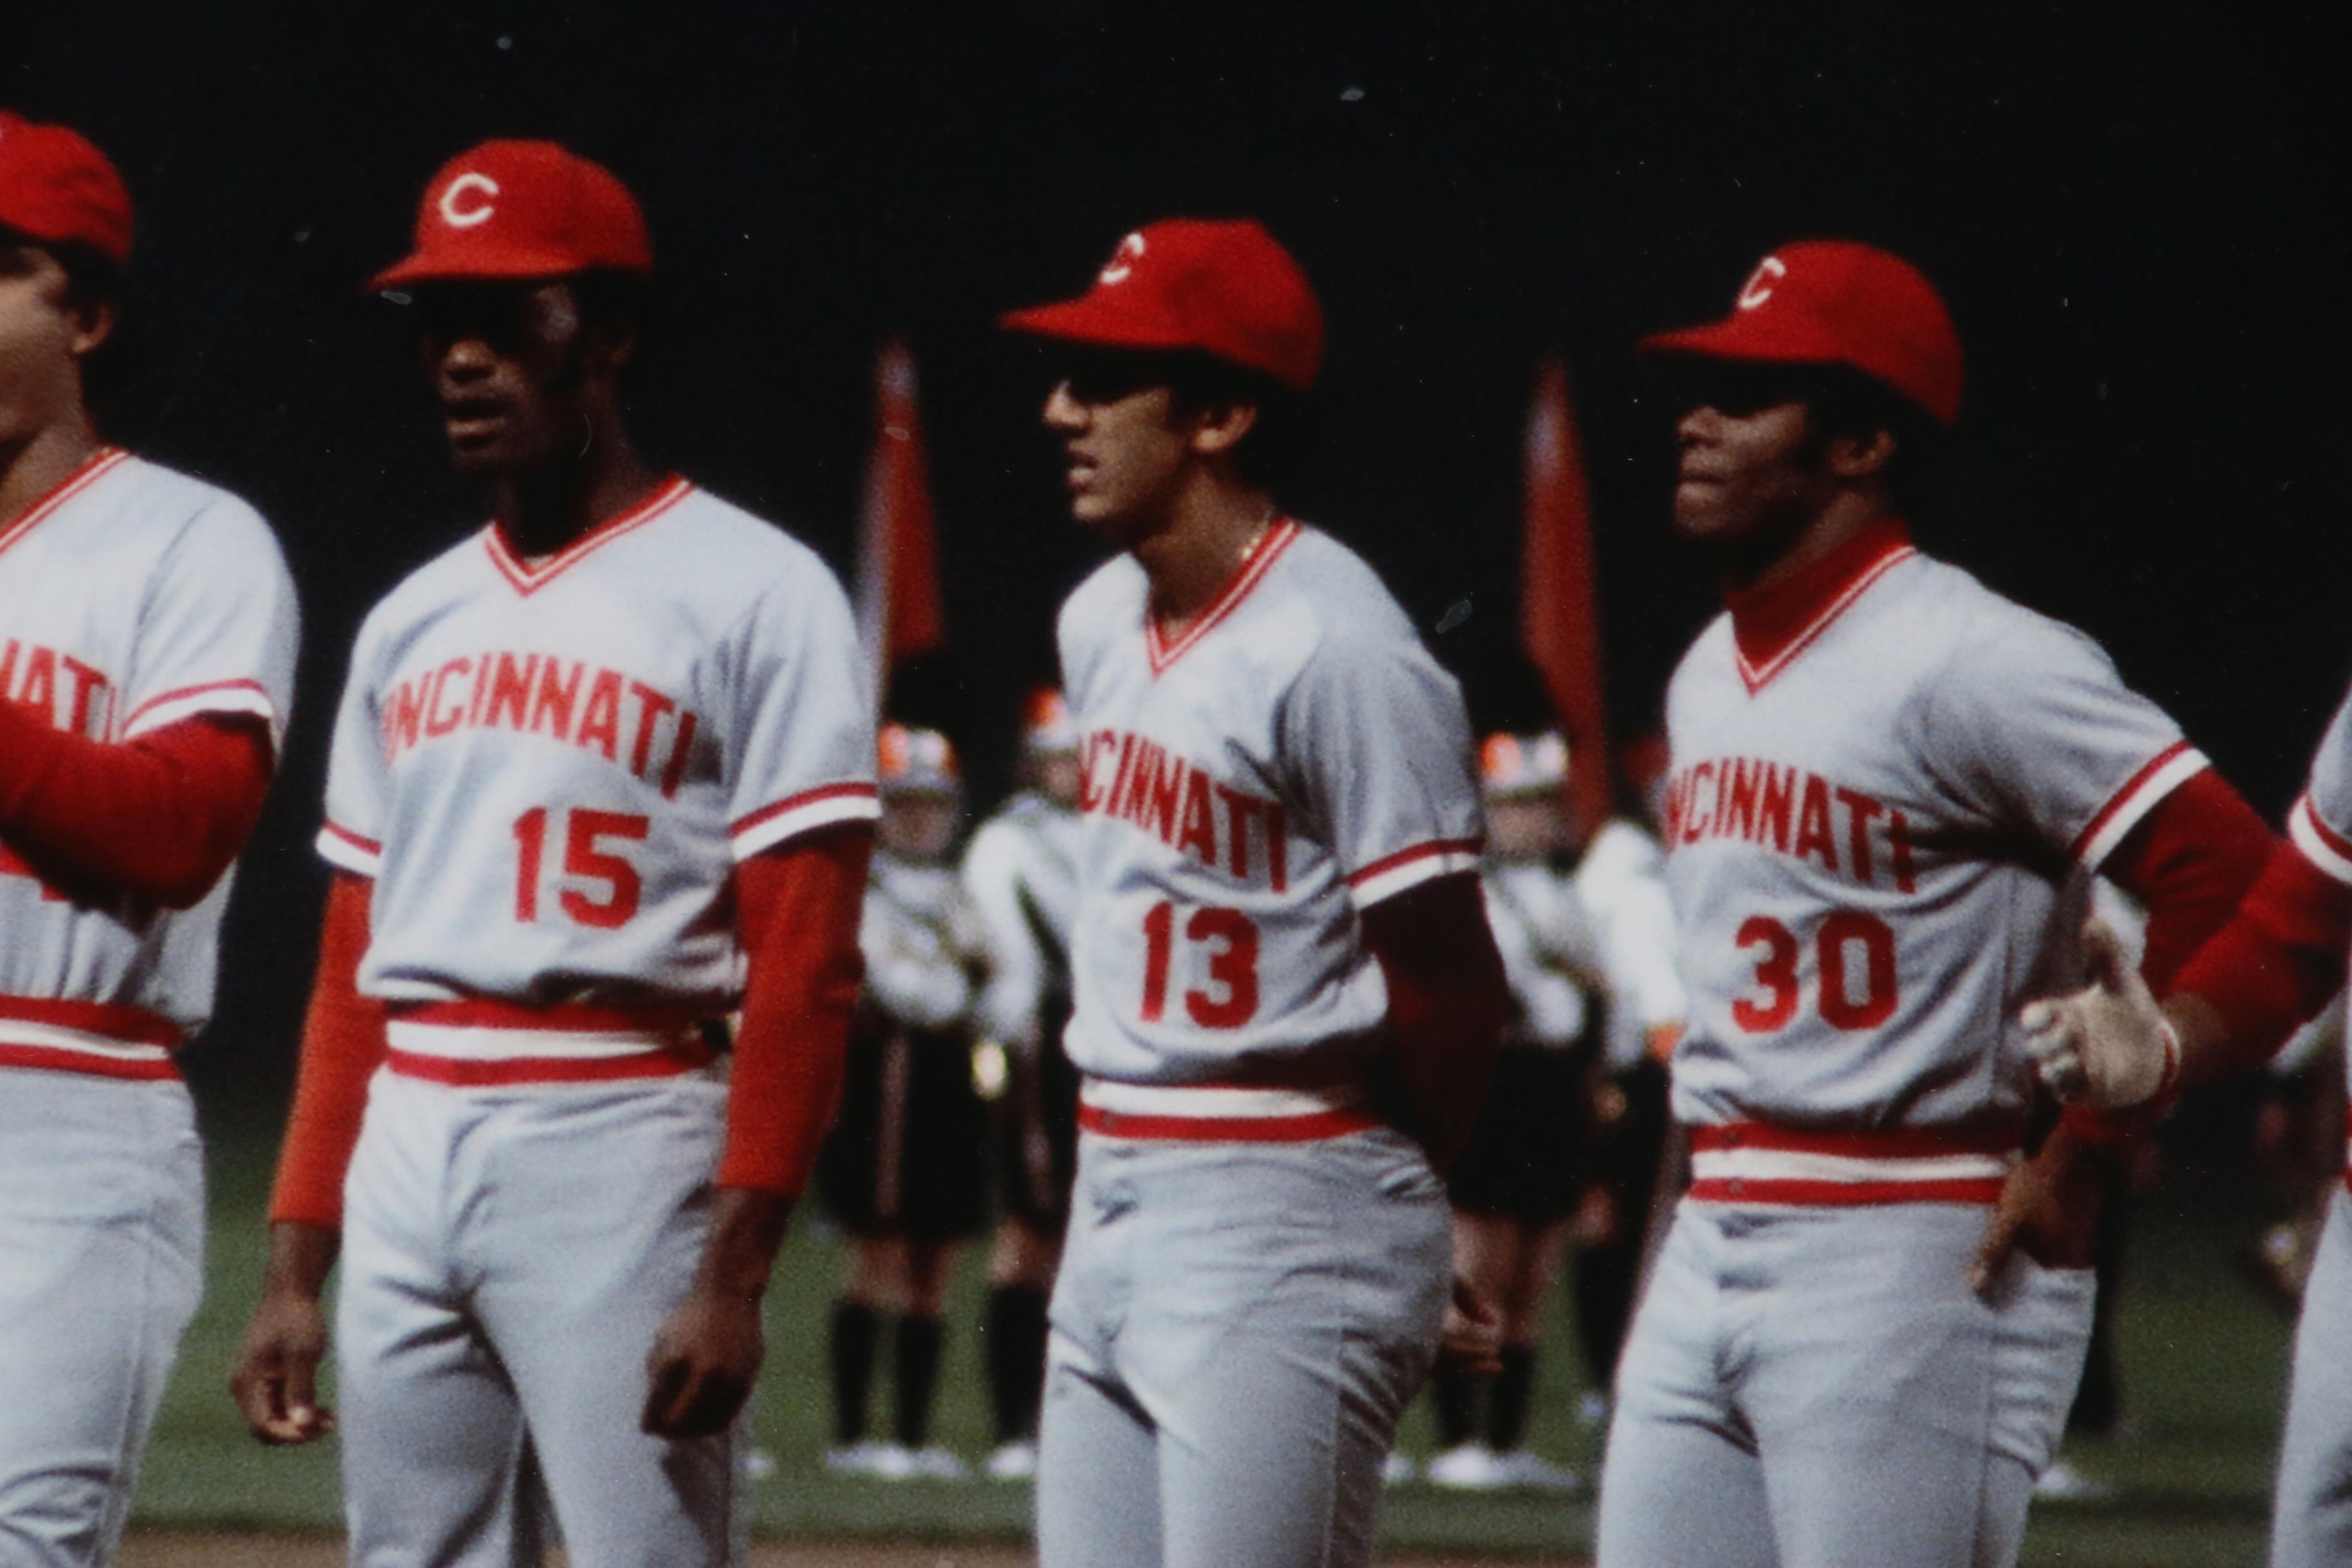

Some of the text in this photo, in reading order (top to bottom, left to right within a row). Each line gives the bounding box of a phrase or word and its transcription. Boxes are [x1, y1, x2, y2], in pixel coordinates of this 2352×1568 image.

[440, 173, 500, 228] C
[1738, 257, 1786, 309] C
[513, 807, 649, 930] 15
[1140, 900, 1259, 1029] 13
[1732, 911, 1899, 1033] 30
